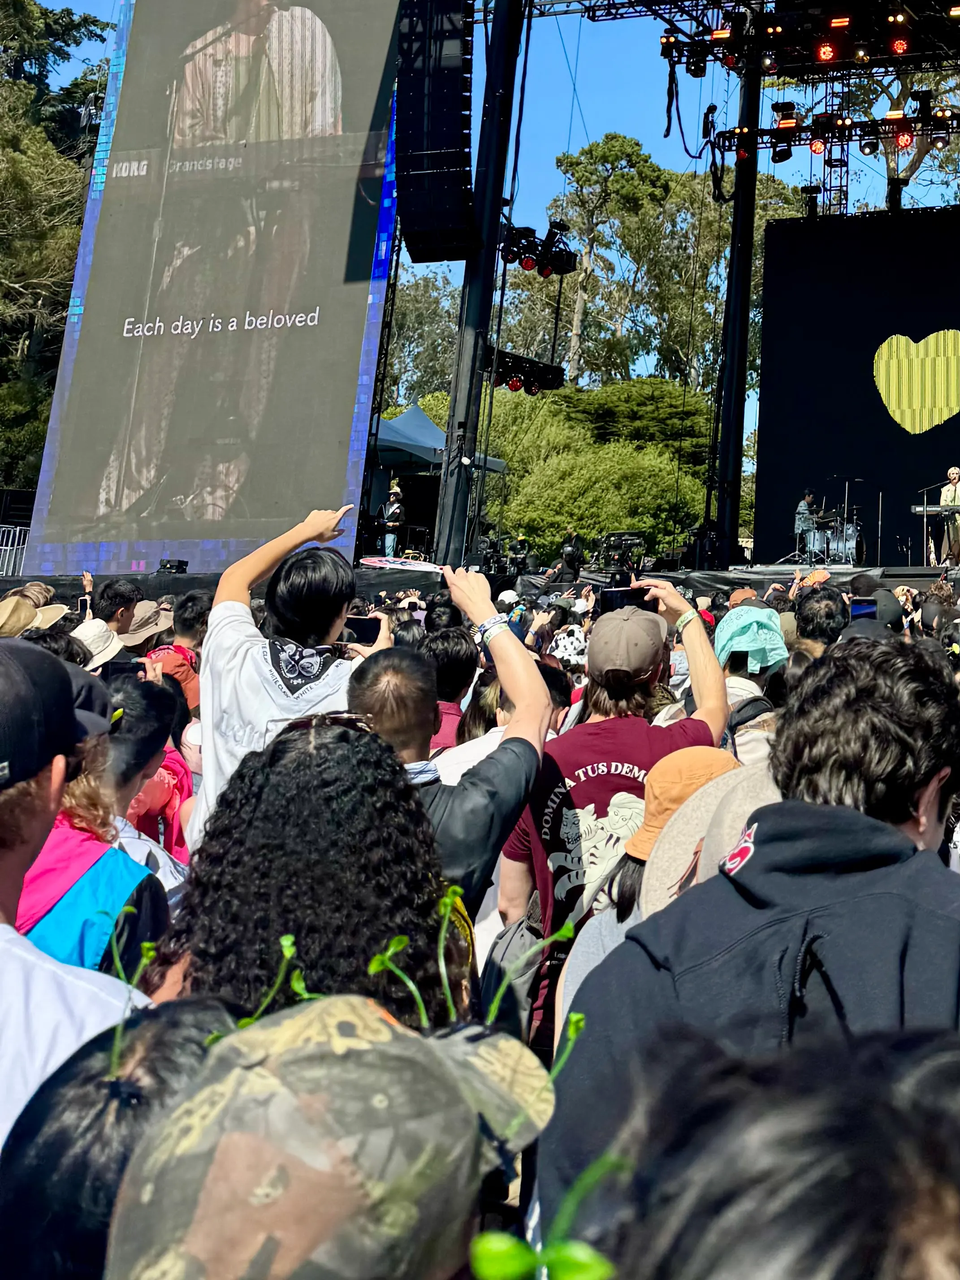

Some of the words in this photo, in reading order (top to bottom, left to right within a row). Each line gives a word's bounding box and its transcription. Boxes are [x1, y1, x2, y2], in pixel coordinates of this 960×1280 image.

[112, 160, 148, 178] KORG
[123, 317, 165, 337] Each
[171, 315, 204, 339] day
[209, 313, 223, 332] is
[228, 317, 238, 331] a
[244, 306, 320, 330] beloved
[293, 684, 314, 701] WHITE
[541, 777, 577, 841] DOMINA
[574, 762, 608, 782] TUS
